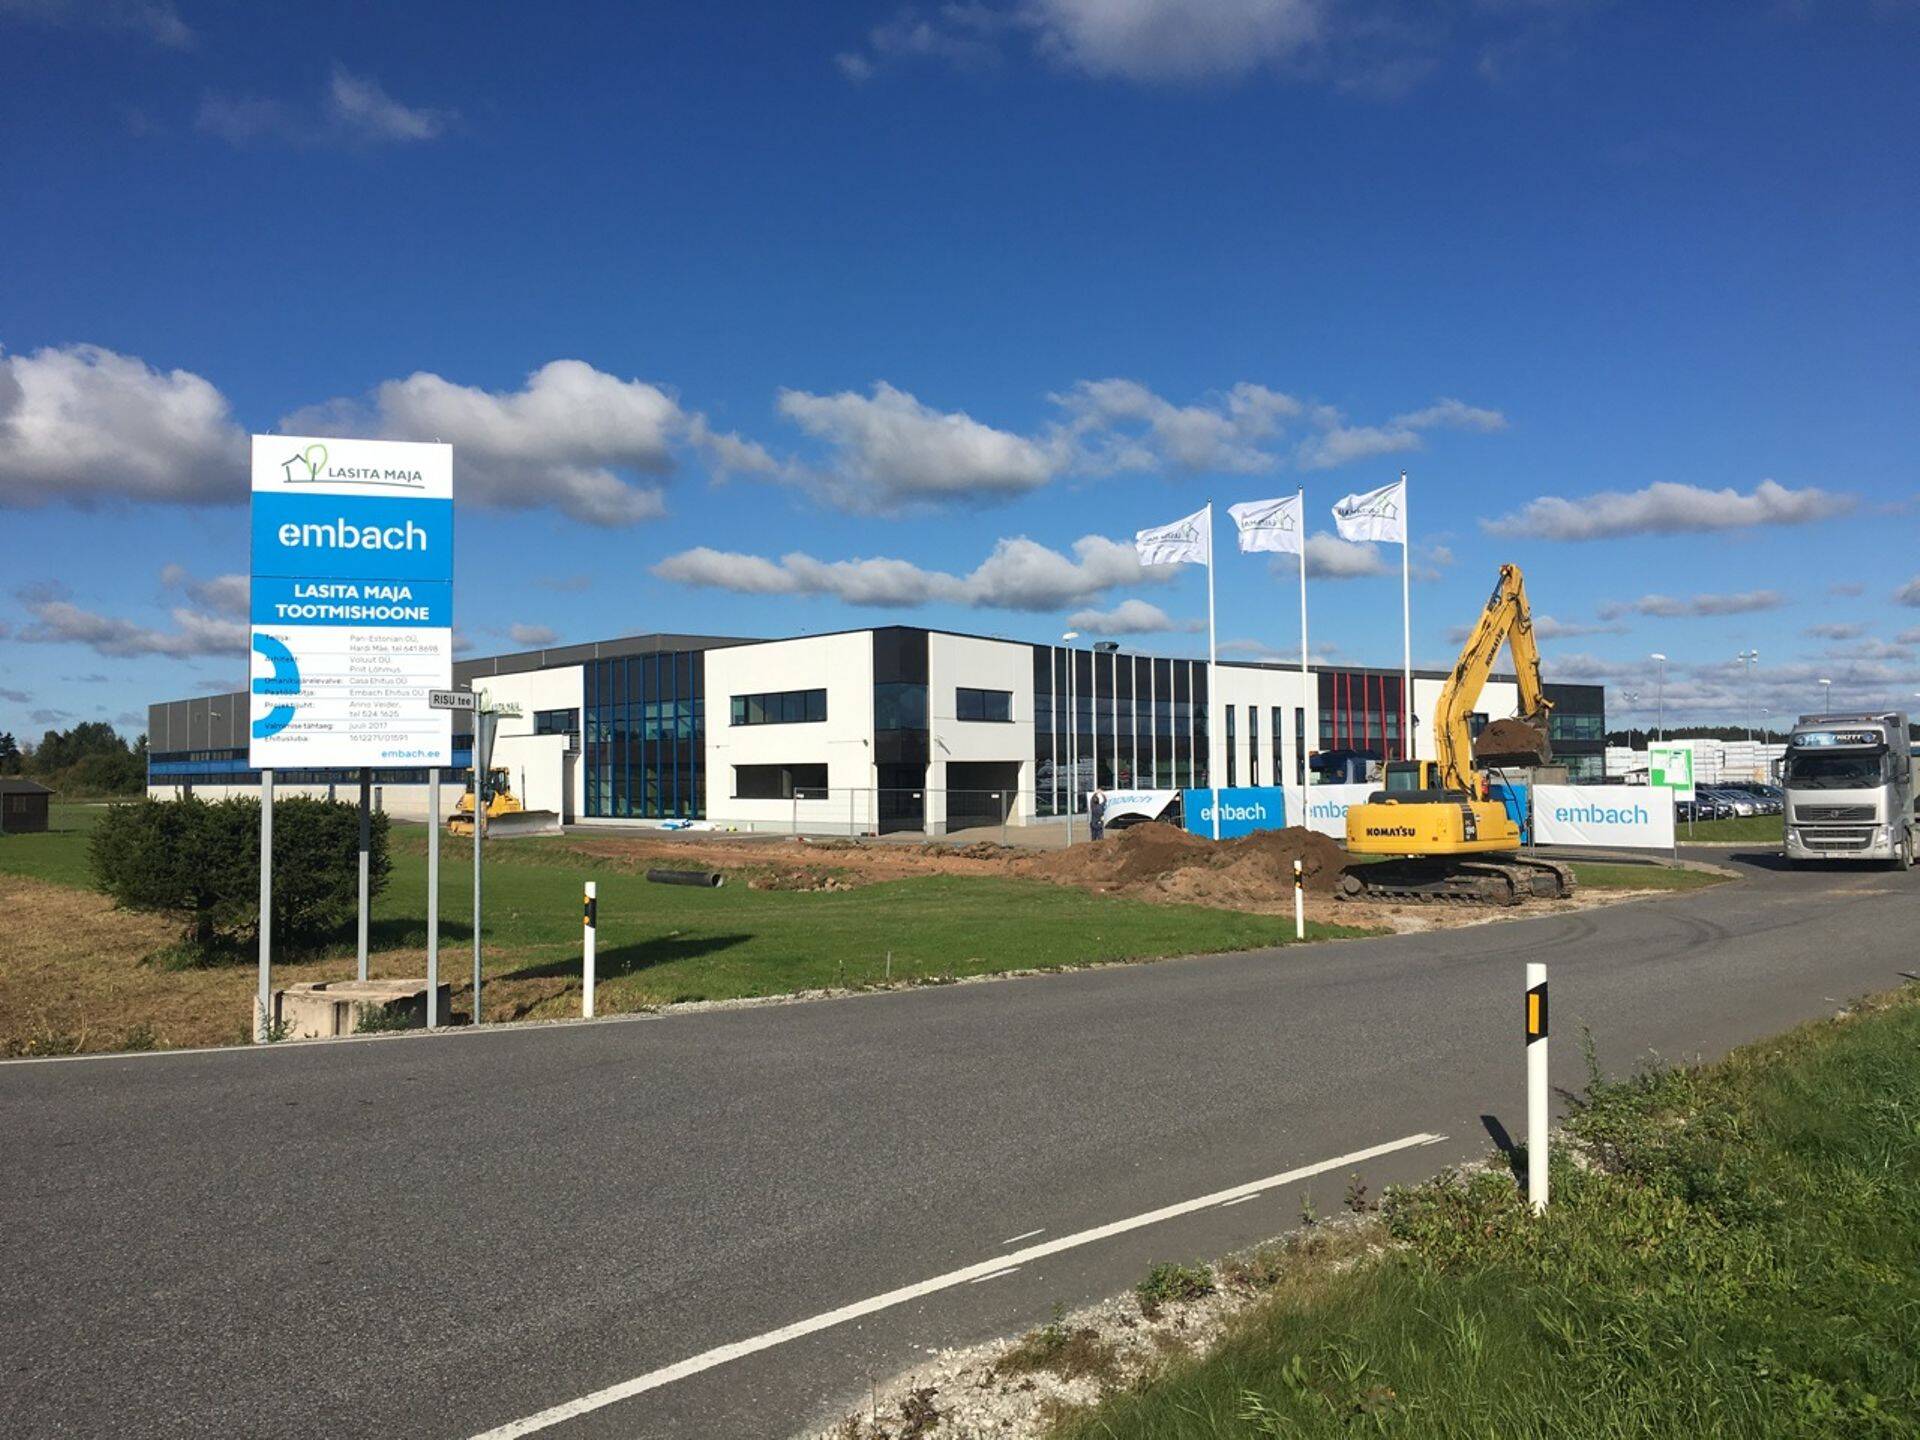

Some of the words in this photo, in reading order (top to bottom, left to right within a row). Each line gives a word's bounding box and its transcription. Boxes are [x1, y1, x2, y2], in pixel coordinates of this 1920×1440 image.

[328, 467, 381, 480] LASITA
[384, 470, 423, 482] MAJA
[278, 518, 427, 550] embach
[294, 583, 359, 599] LASITA
[364, 585, 413, 602] MAJA
[275, 603, 430, 620] TOOTMISHOONE
[391, 644, 402, 652] tel
[348, 689, 383, 697] Embach
[384, 689, 410, 697] Ehitus
[433, 694, 455, 706] RISU
[457, 696, 472, 706] tee
[381, 749, 441, 759] embach.ee
[1555, 803, 1648, 824] embach
[1366, 826, 1416, 837] KOMATSU
